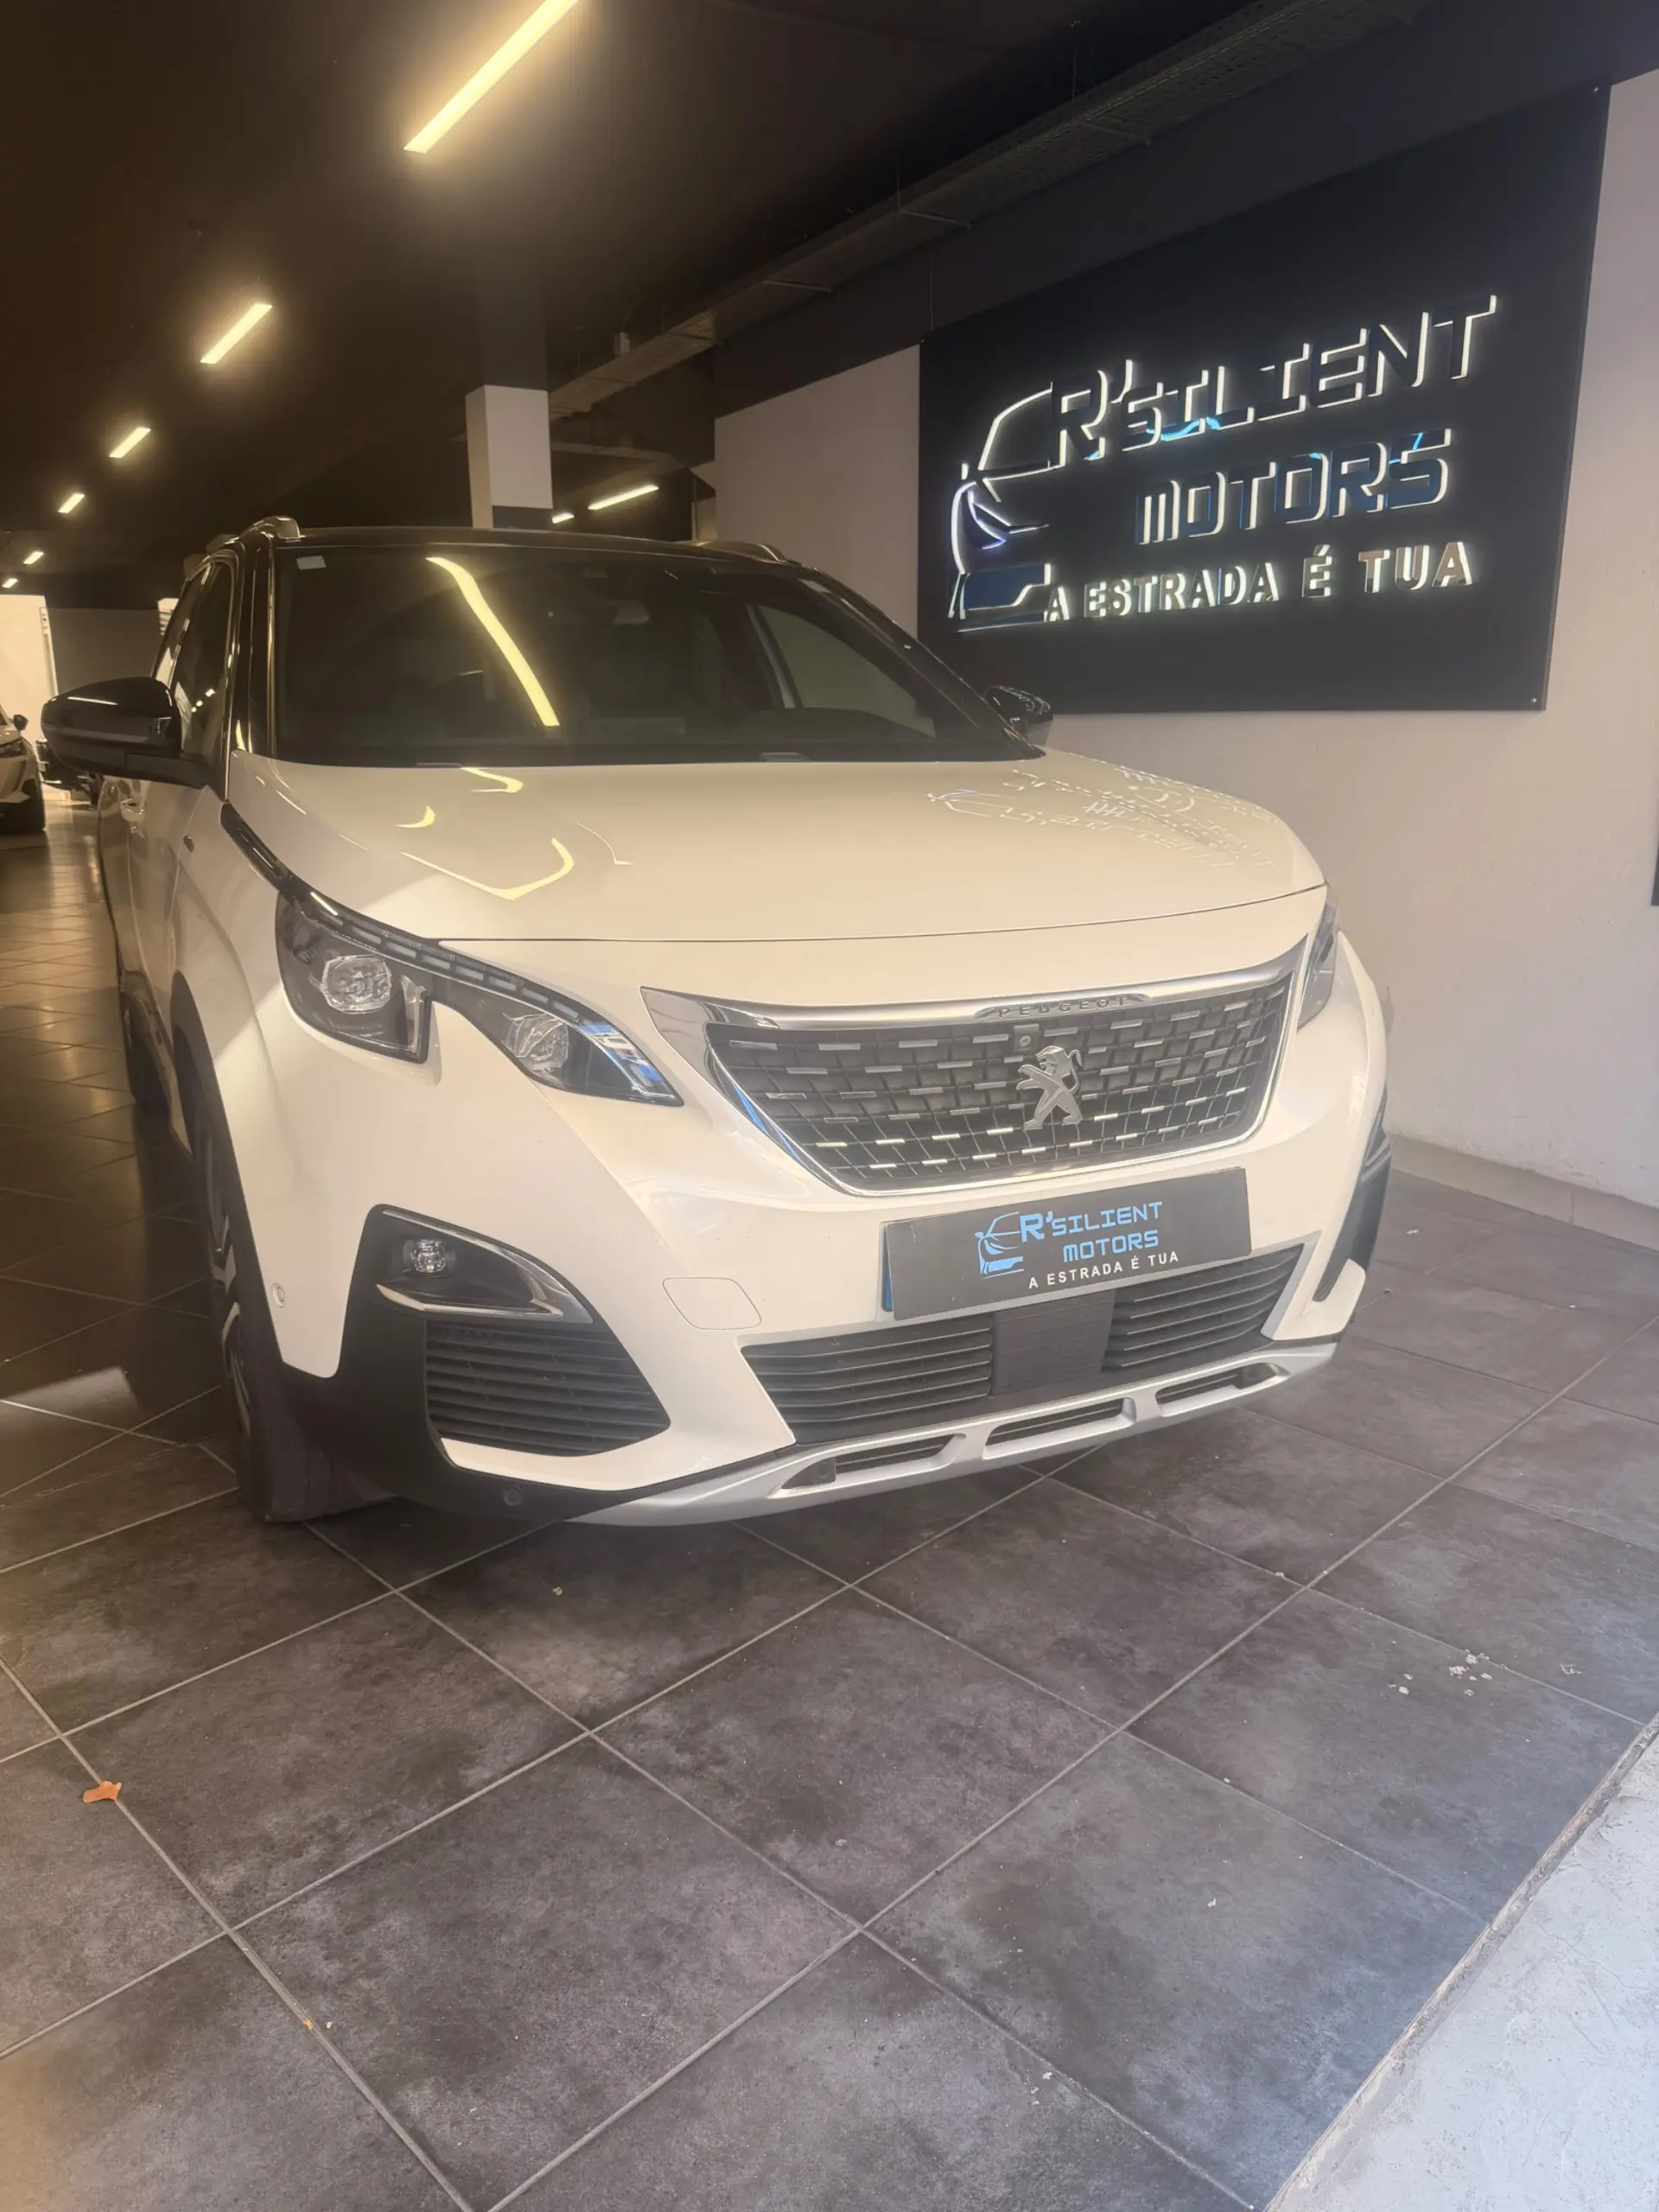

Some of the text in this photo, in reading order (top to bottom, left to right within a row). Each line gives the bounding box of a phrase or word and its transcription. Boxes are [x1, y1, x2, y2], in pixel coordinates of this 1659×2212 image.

[1137, 429, 1452, 544] MOTORS
[1043, 541, 1472, 622] A ESTRADA É TUA
[997, 996, 1128, 1018] PEUGEOT
[1063, 1229, 1159, 1262] MOTORS
[1028, 1250, 1179, 1289] A ESTRADA É TUA
